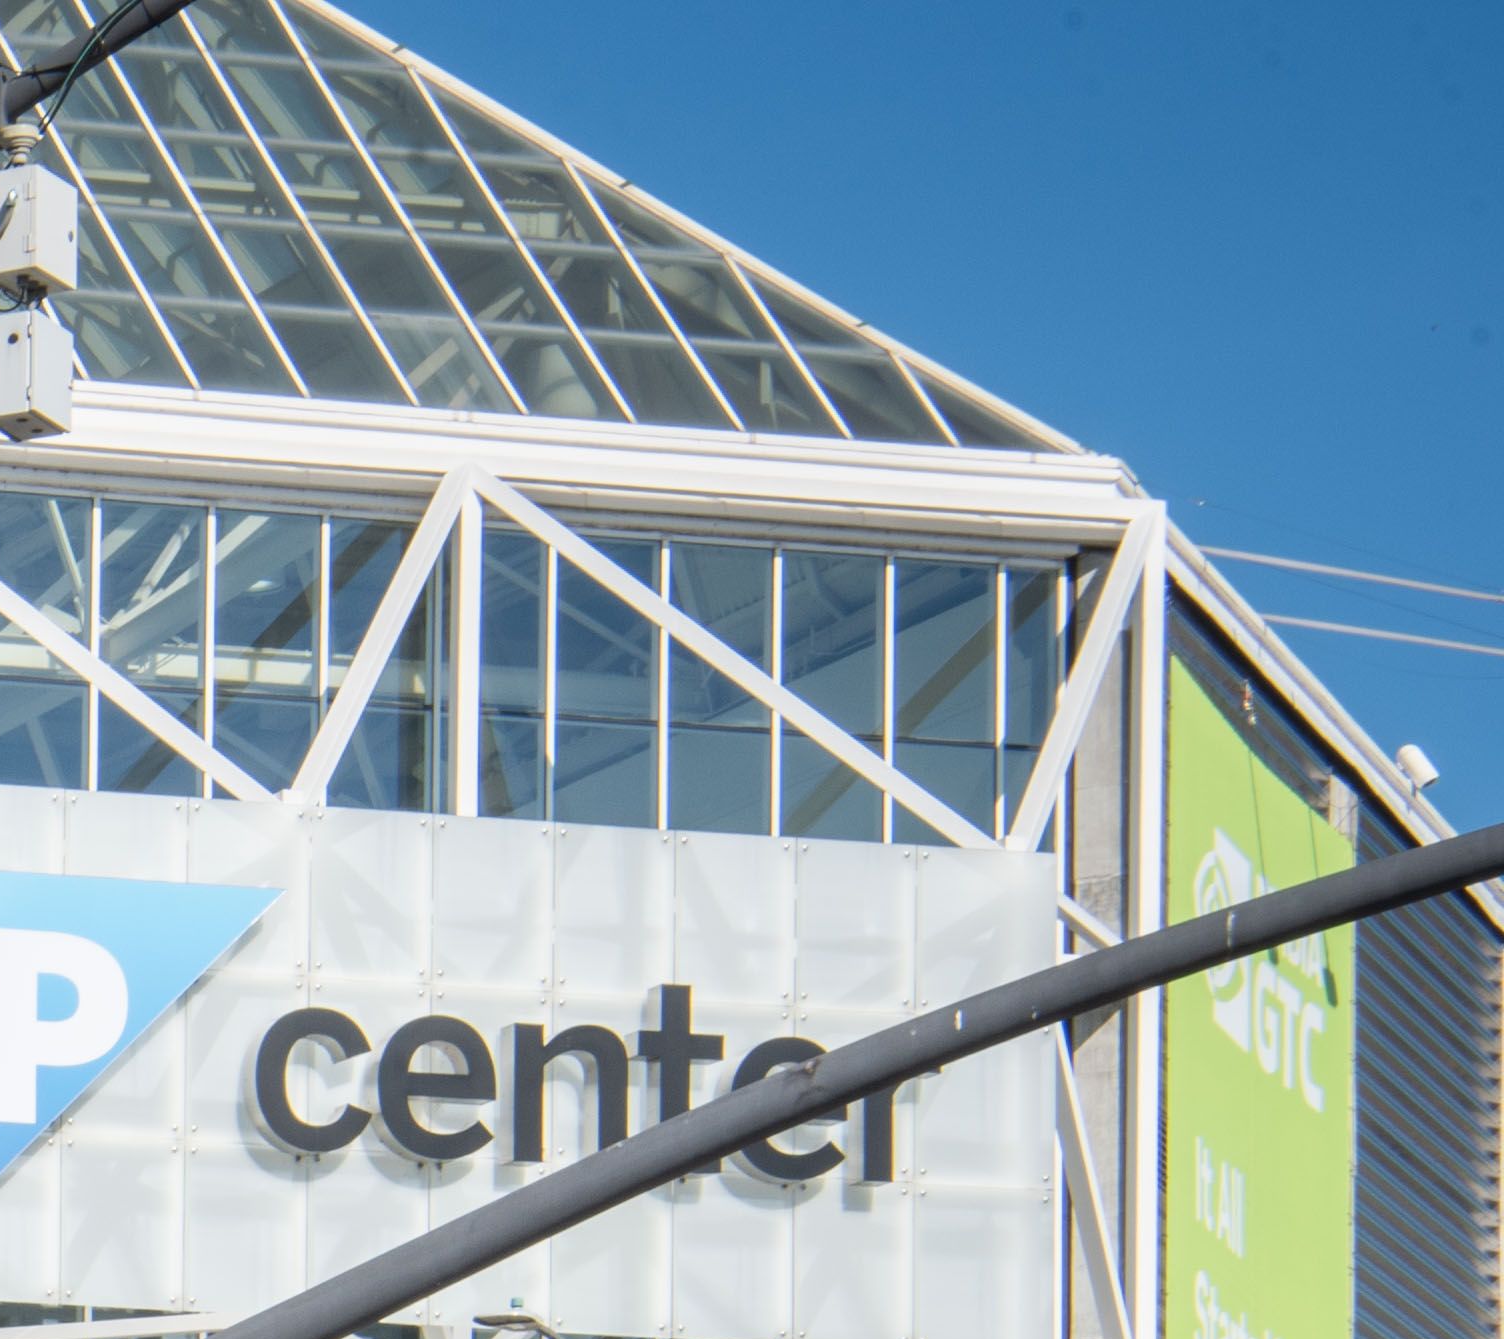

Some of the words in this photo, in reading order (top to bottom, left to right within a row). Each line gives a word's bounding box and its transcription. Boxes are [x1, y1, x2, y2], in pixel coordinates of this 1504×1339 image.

[256, 984, 942, 1184] center
[1255, 958, 1325, 1114] GTC
[1195, 1135, 1215, 1231] It
[1217, 1160, 1246, 1258] All
